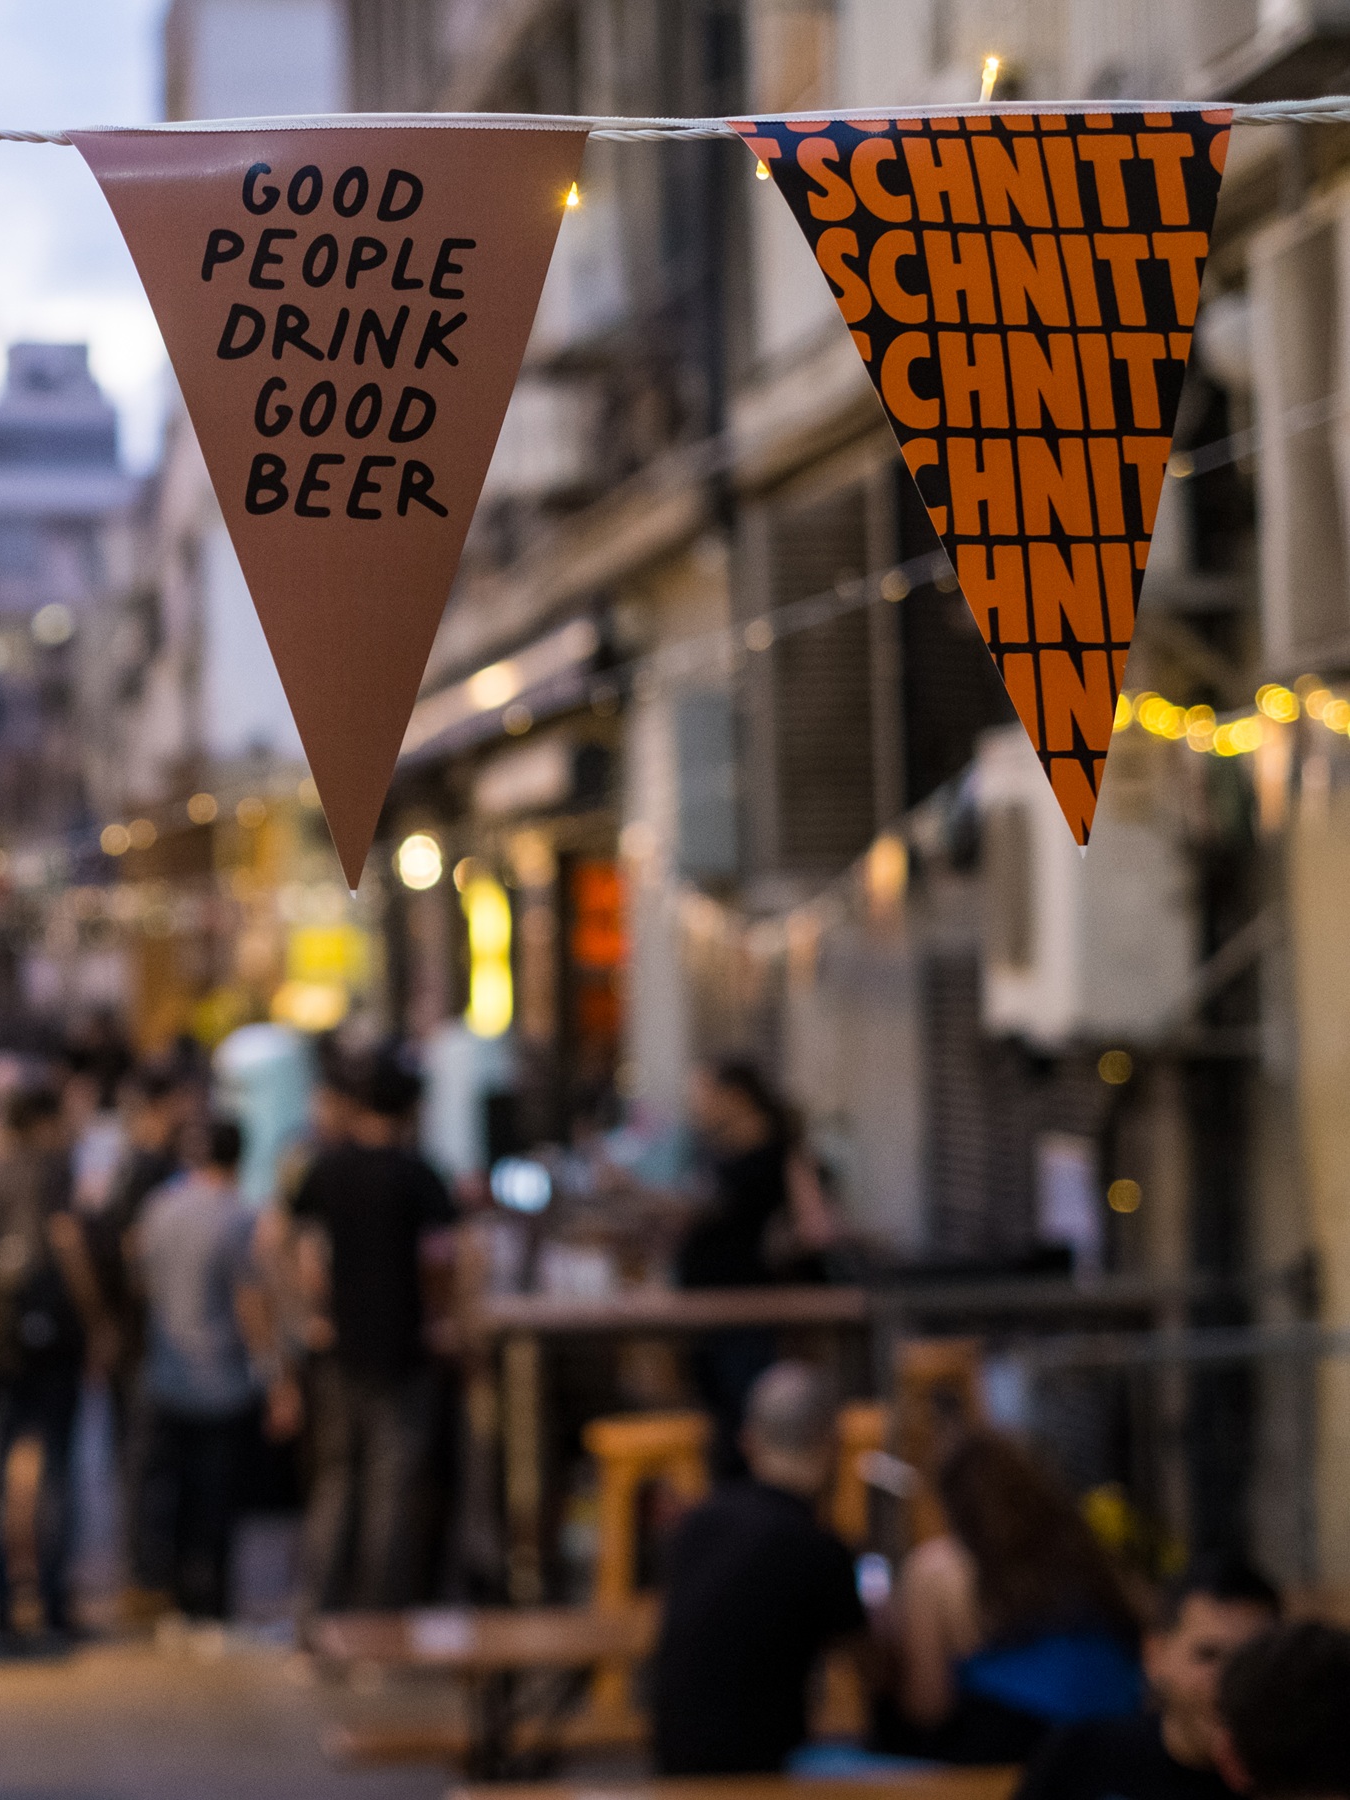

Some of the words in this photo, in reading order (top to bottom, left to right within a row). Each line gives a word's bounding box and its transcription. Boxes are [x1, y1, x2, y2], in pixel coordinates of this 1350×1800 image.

[242, 162, 424, 222] GOOD
[796, 132, 1195, 229] SCHNITT
[201, 228, 477, 300] PEOPLE
[815, 227, 1209, 328] SCHNITT
[217, 303, 468, 369] DRINK
[254, 376, 437, 443] GOOD
[245, 452, 449, 520] BEER
